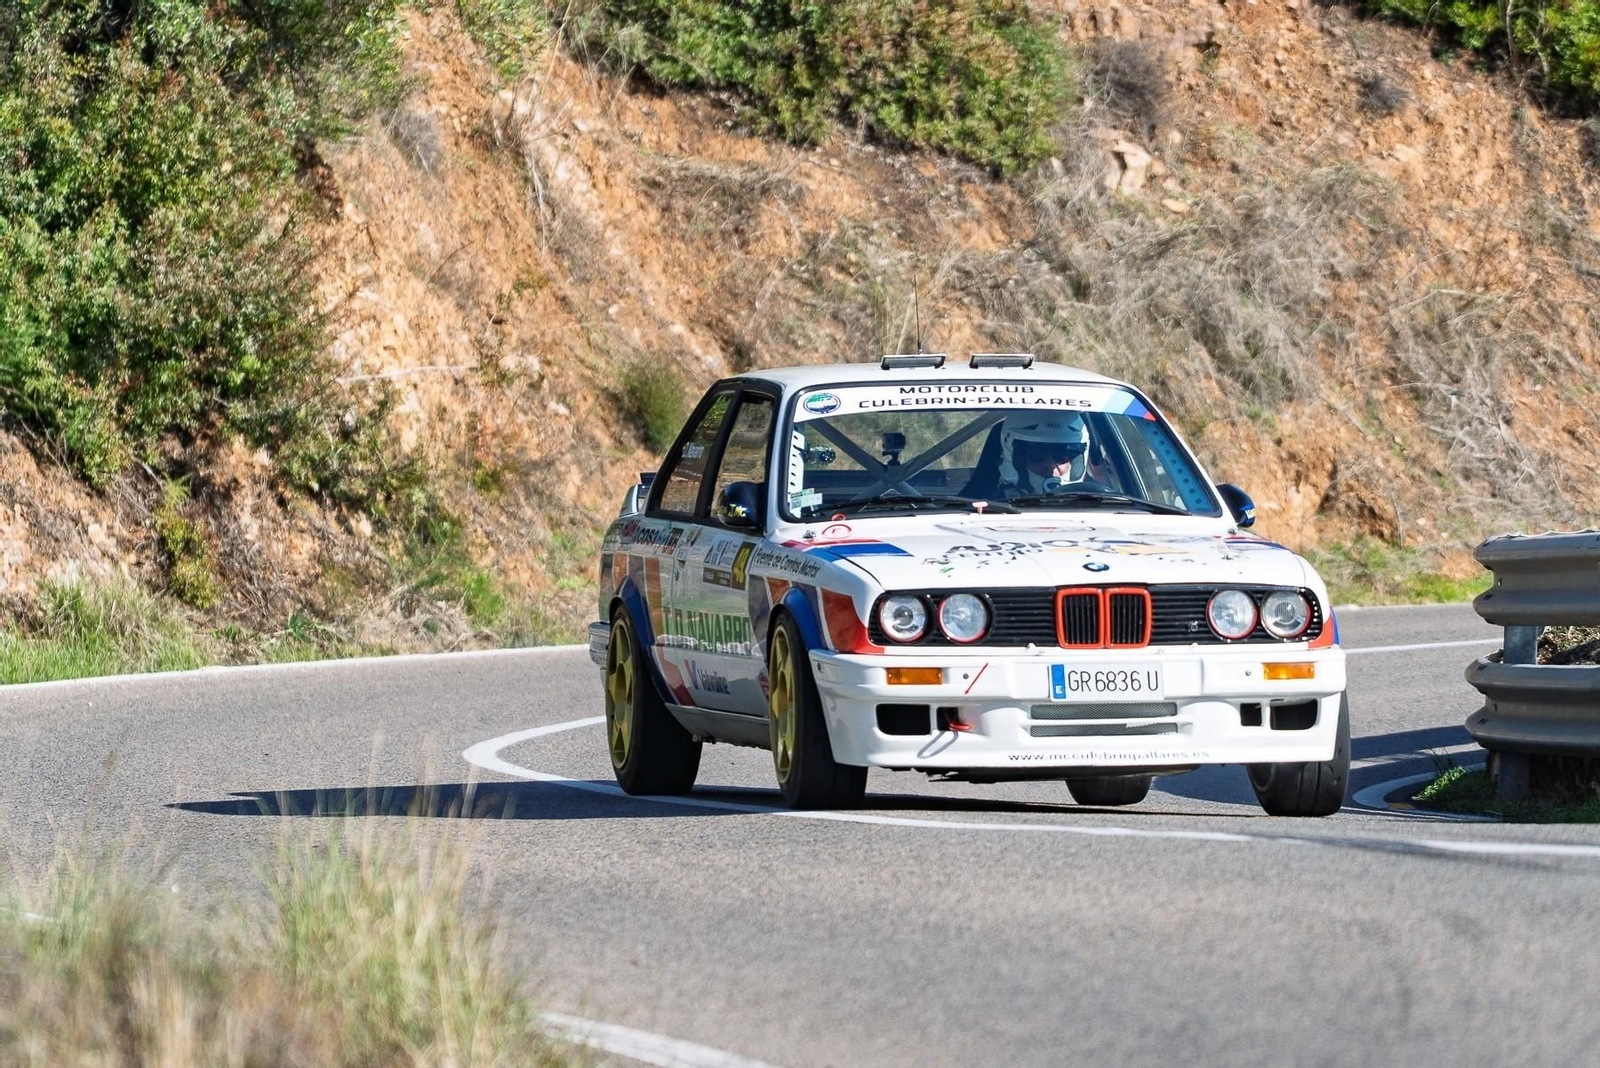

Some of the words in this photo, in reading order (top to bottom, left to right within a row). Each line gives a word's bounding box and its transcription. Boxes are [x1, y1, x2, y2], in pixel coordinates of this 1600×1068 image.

[899, 385, 1035, 394] MOTORCLUB
[858, 397, 1092, 409] CULEBRIN-PALLARES
[1147, 670, 1159, 692] U
[1055, 685, 1063, 694] E
